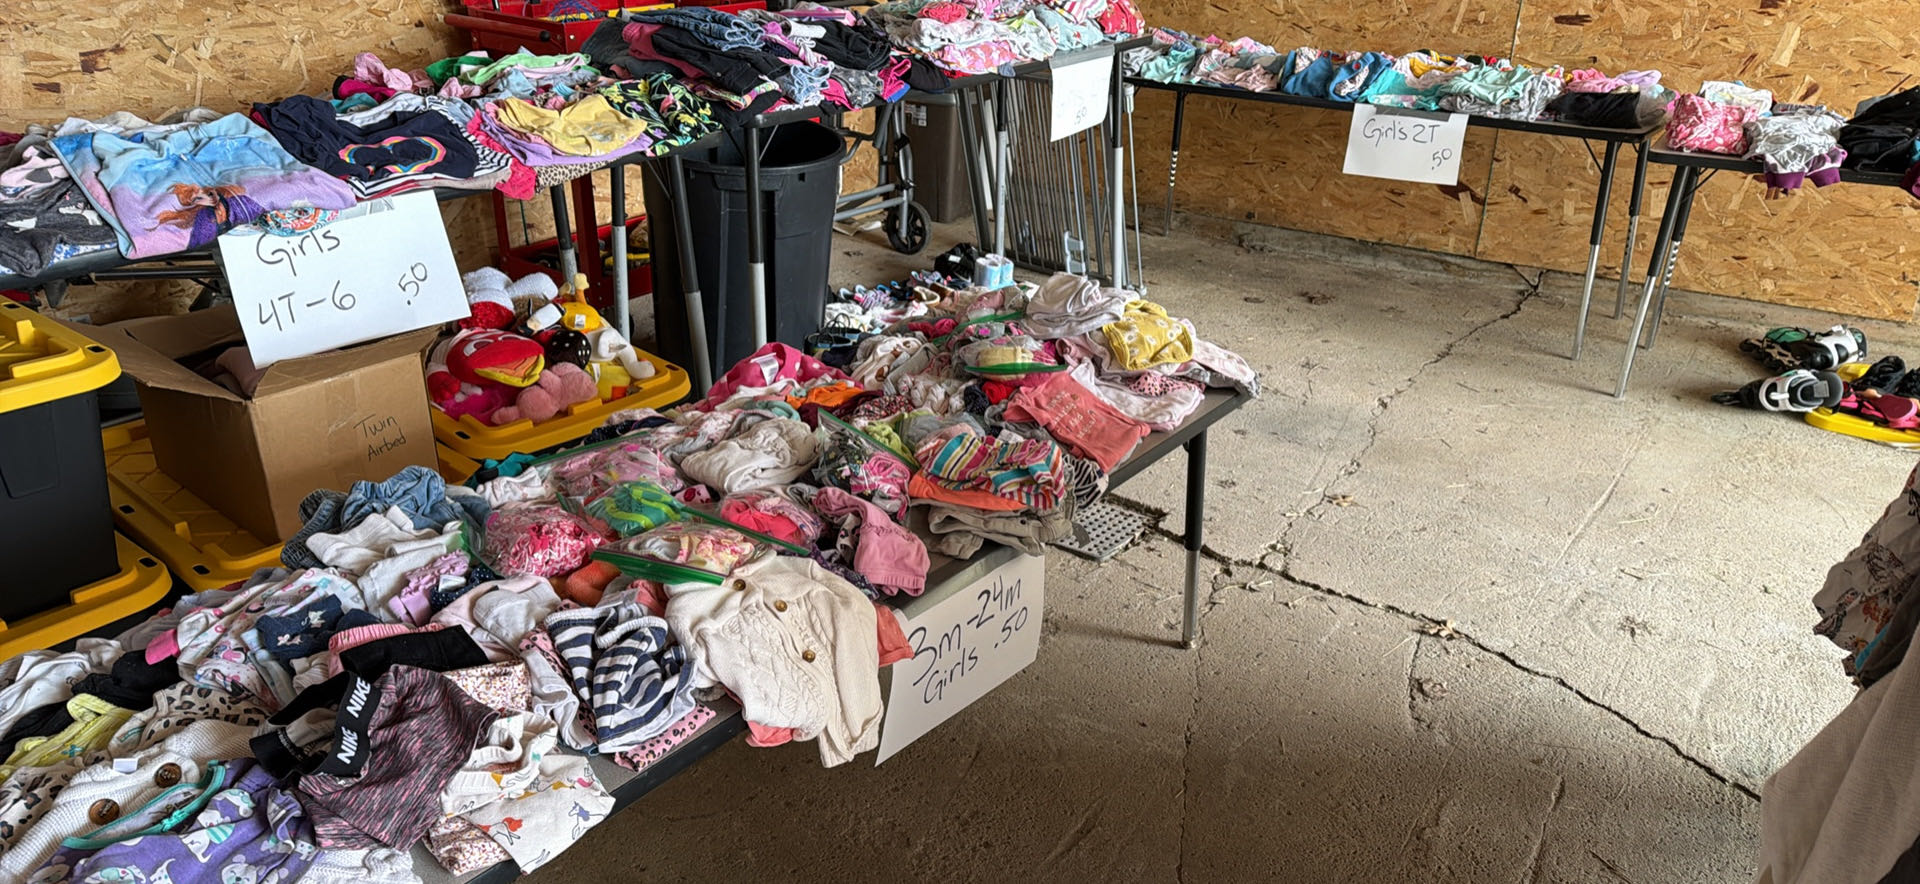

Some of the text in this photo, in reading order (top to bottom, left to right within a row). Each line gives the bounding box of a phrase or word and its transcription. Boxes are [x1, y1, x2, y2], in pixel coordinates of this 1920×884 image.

[1412, 124, 1440, 143] 2T
[1432, 148, 1453, 171] .50
[256, 230, 340, 276] Girls
[398, 262, 428, 306] .50
[353, 413, 398, 438] Twin
[367, 427, 407, 462] Airbed
[924, 606, 1028, 704] Girls .50
[346, 676, 371, 718] NIKE
[337, 726, 359, 764] NIKE
